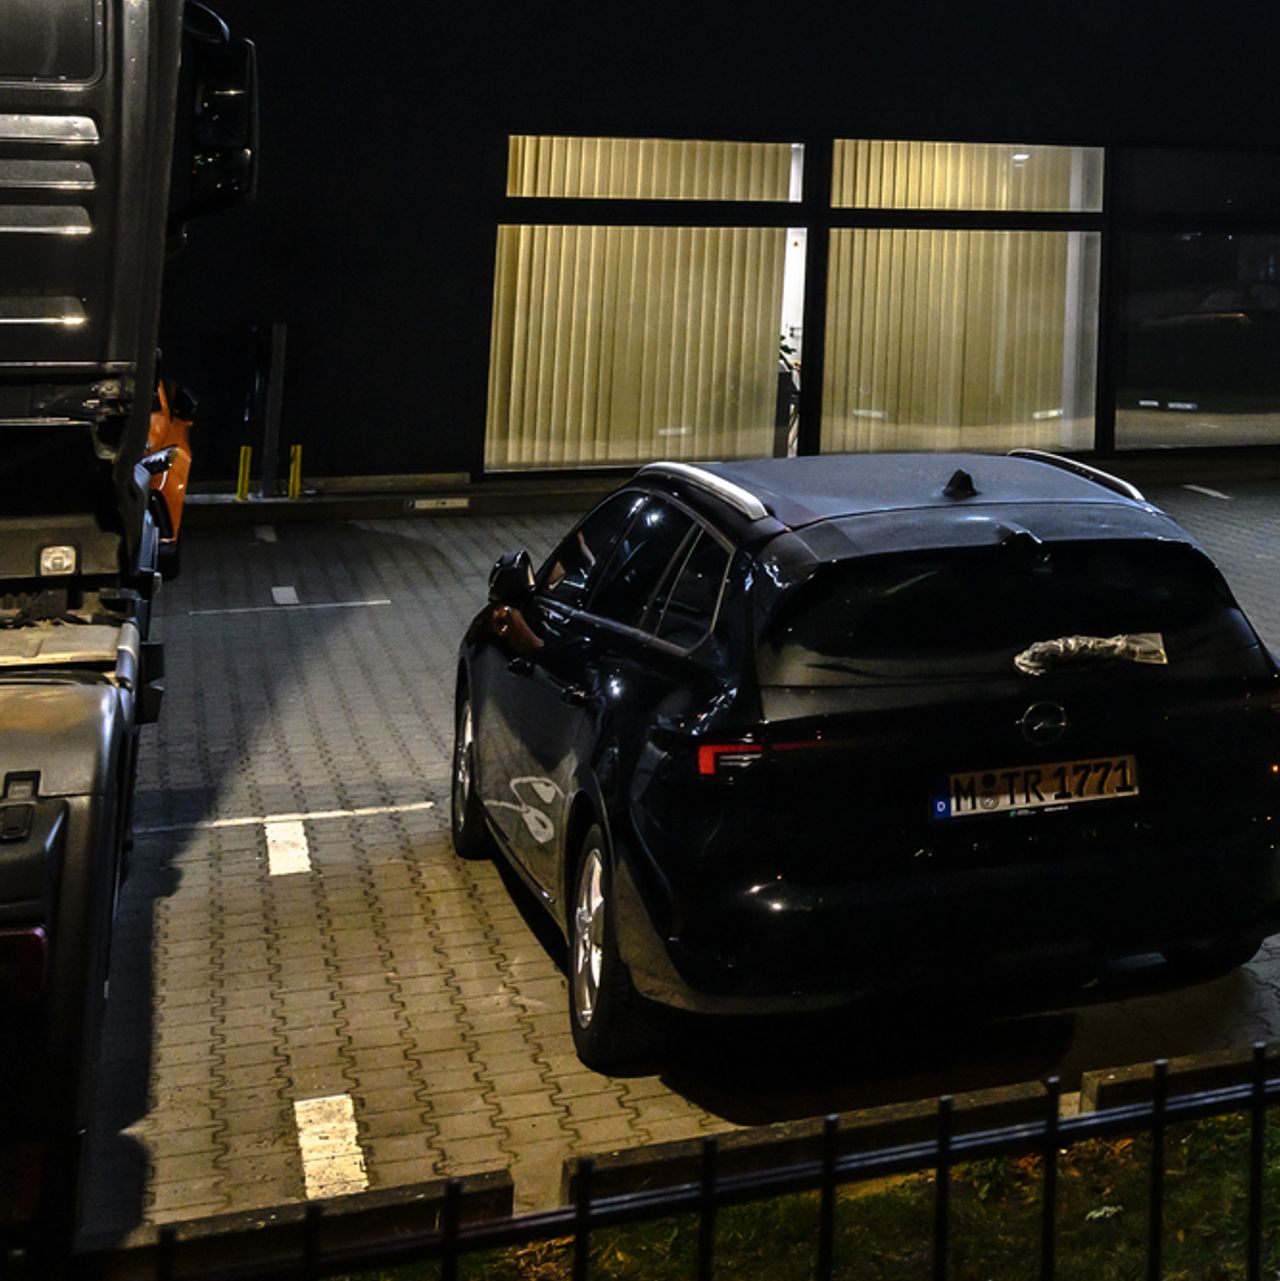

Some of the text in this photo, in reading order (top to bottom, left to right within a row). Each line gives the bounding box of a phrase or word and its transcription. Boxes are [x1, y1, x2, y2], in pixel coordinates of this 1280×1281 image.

[954, 776, 976, 812] M
[1001, 769, 1044, 804] TR
[1053, 760, 1133, 800] 1771
